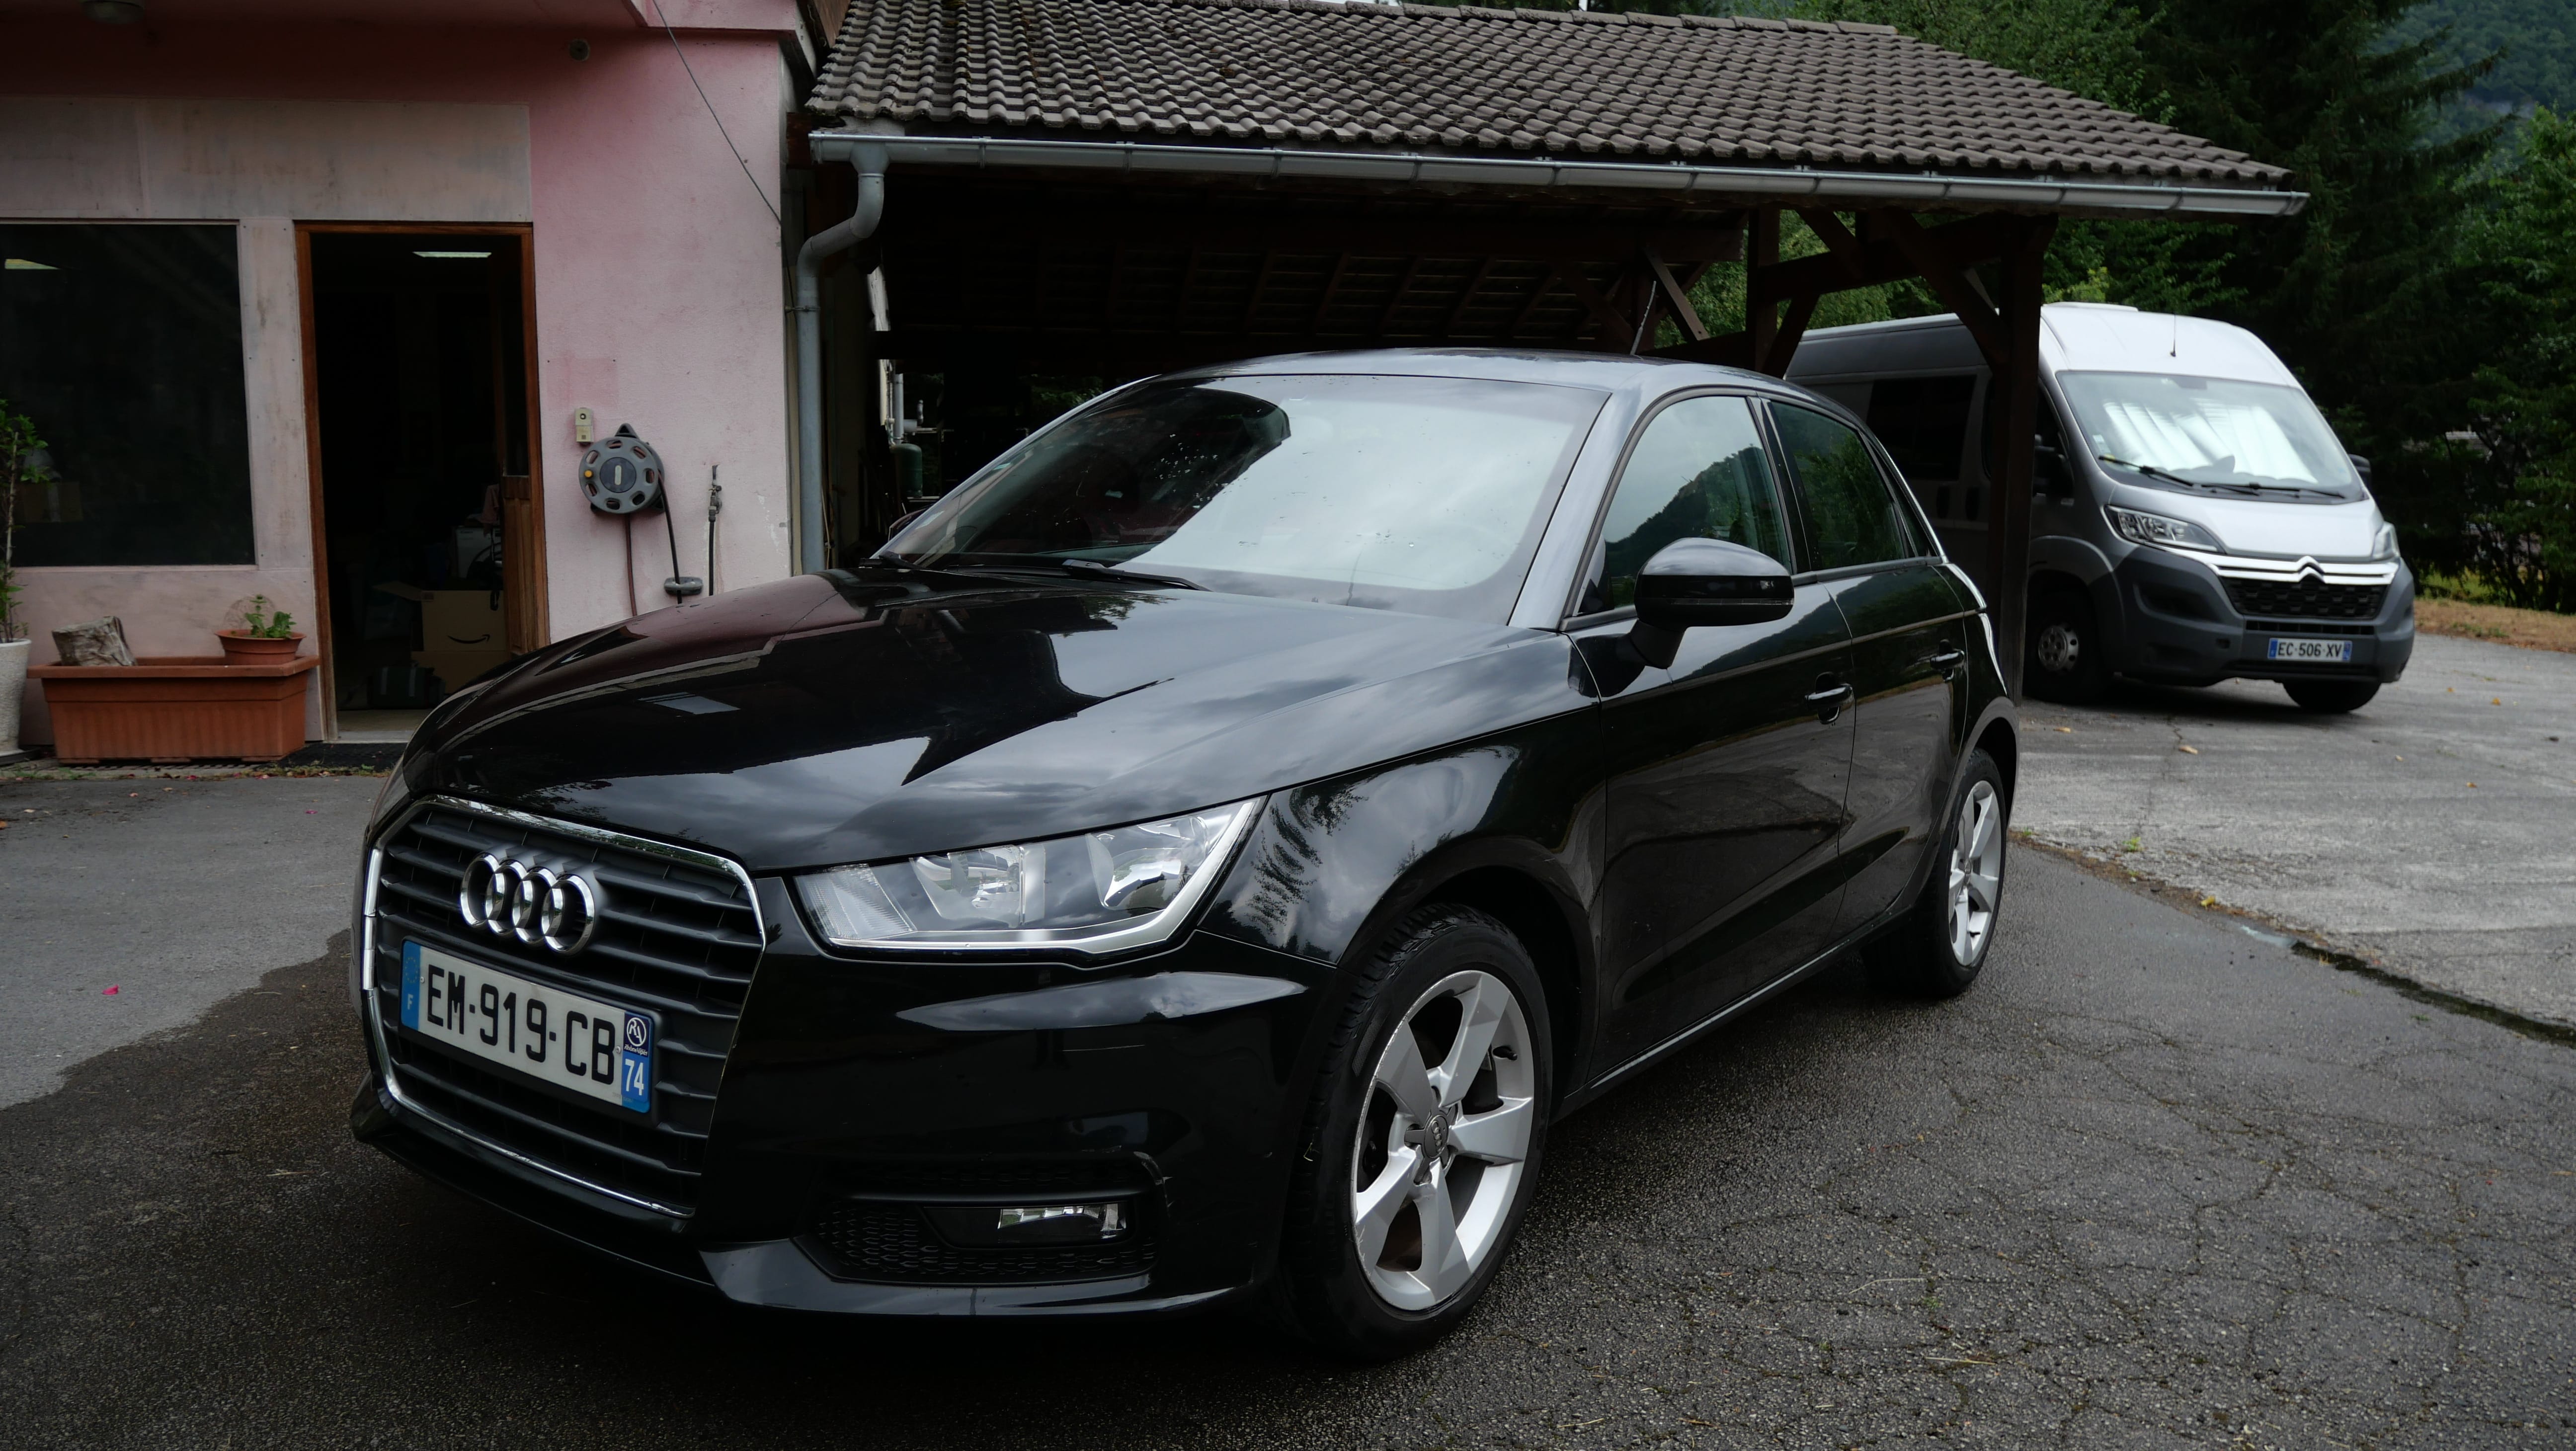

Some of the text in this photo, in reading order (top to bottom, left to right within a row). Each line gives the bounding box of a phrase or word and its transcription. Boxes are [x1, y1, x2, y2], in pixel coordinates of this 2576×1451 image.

[407, 994, 413, 1010] F
[427, 965, 615, 1085] EM-919-CB
[625, 1059, 644, 1096] 74
